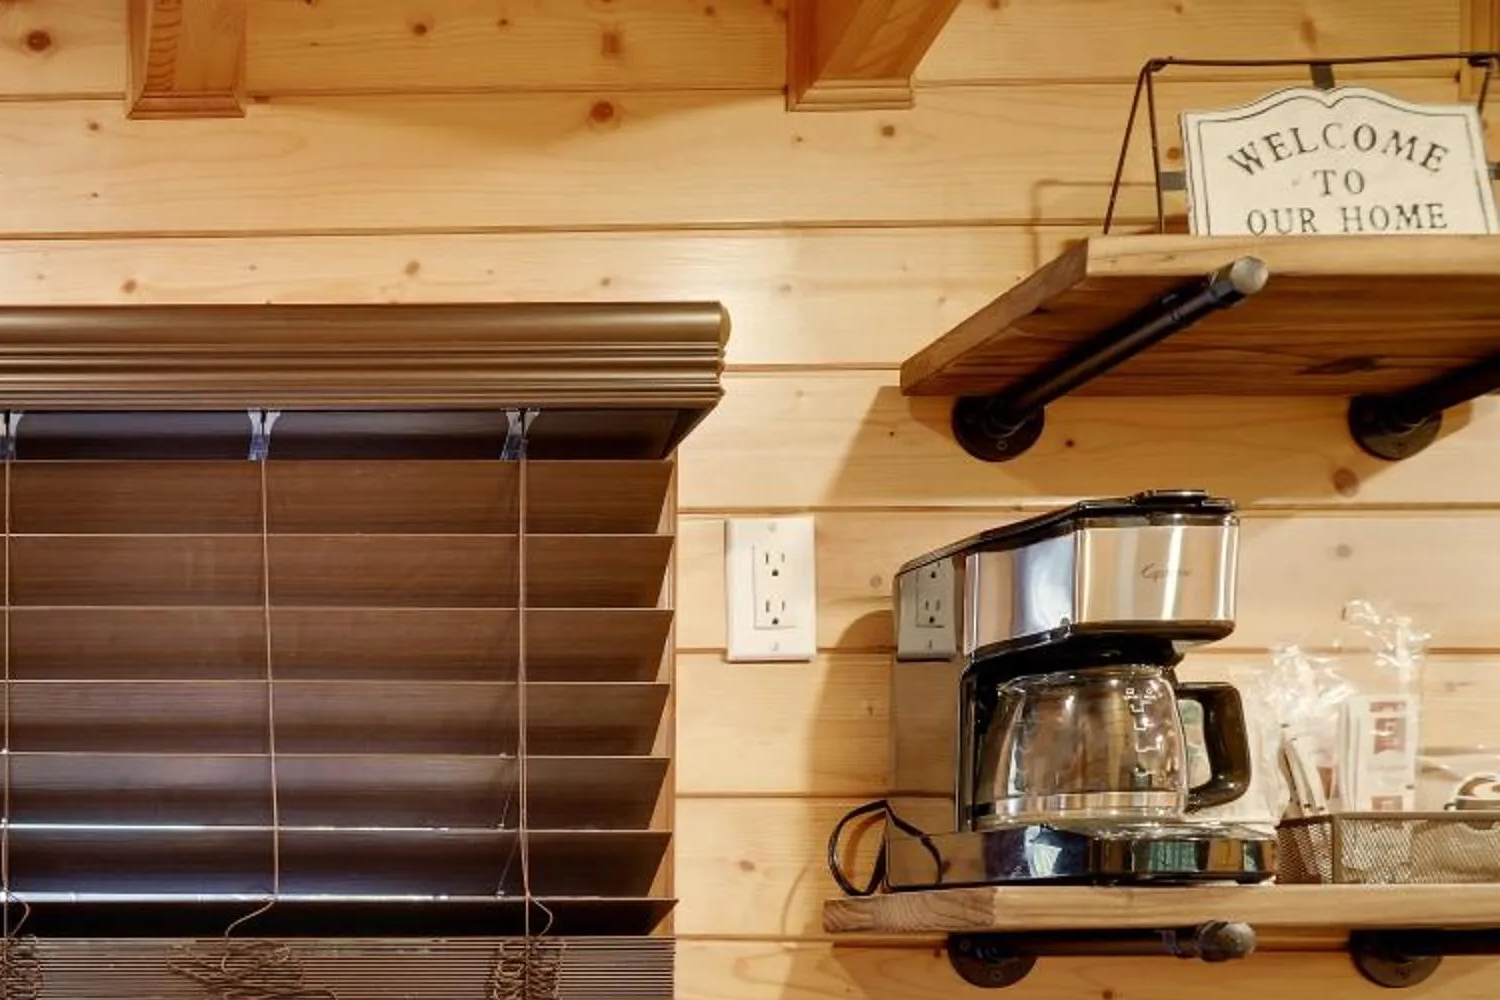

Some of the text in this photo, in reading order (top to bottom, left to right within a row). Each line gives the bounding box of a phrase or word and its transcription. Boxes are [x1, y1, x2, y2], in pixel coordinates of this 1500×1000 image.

[1227, 122, 1449, 176] WELCOME
[1311, 168, 1366, 196] TO
[1246, 202, 1449, 236] OUR HOME
